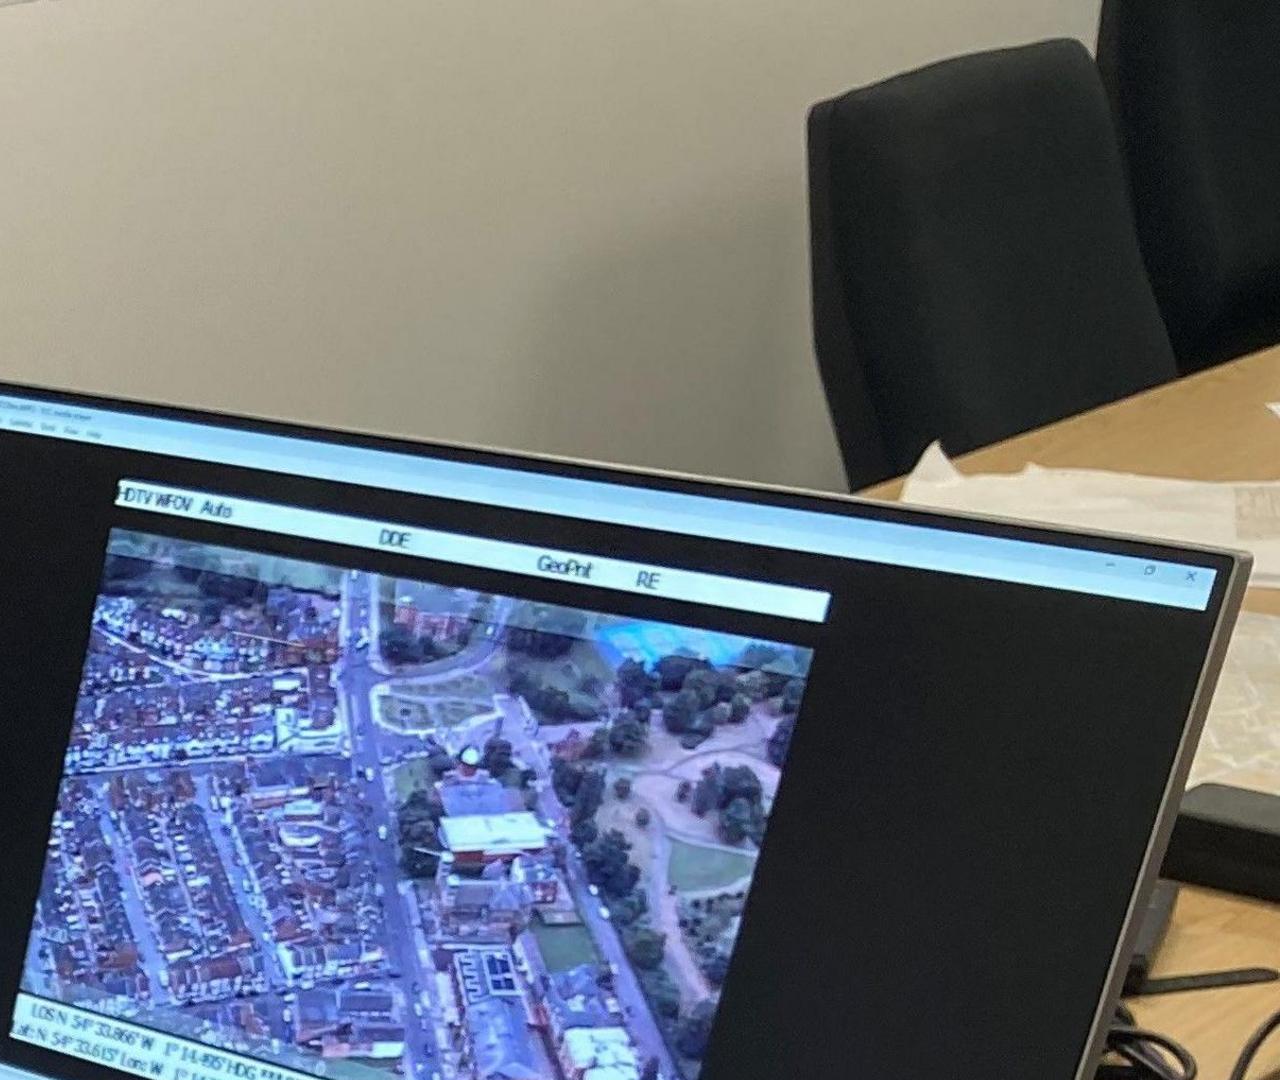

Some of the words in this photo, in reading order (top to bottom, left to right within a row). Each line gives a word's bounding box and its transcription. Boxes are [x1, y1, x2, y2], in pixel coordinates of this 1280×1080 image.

[200, 499, 232, 518] Auto
[378, 528, 411, 548] DDE
[636, 570, 661, 589] RE
